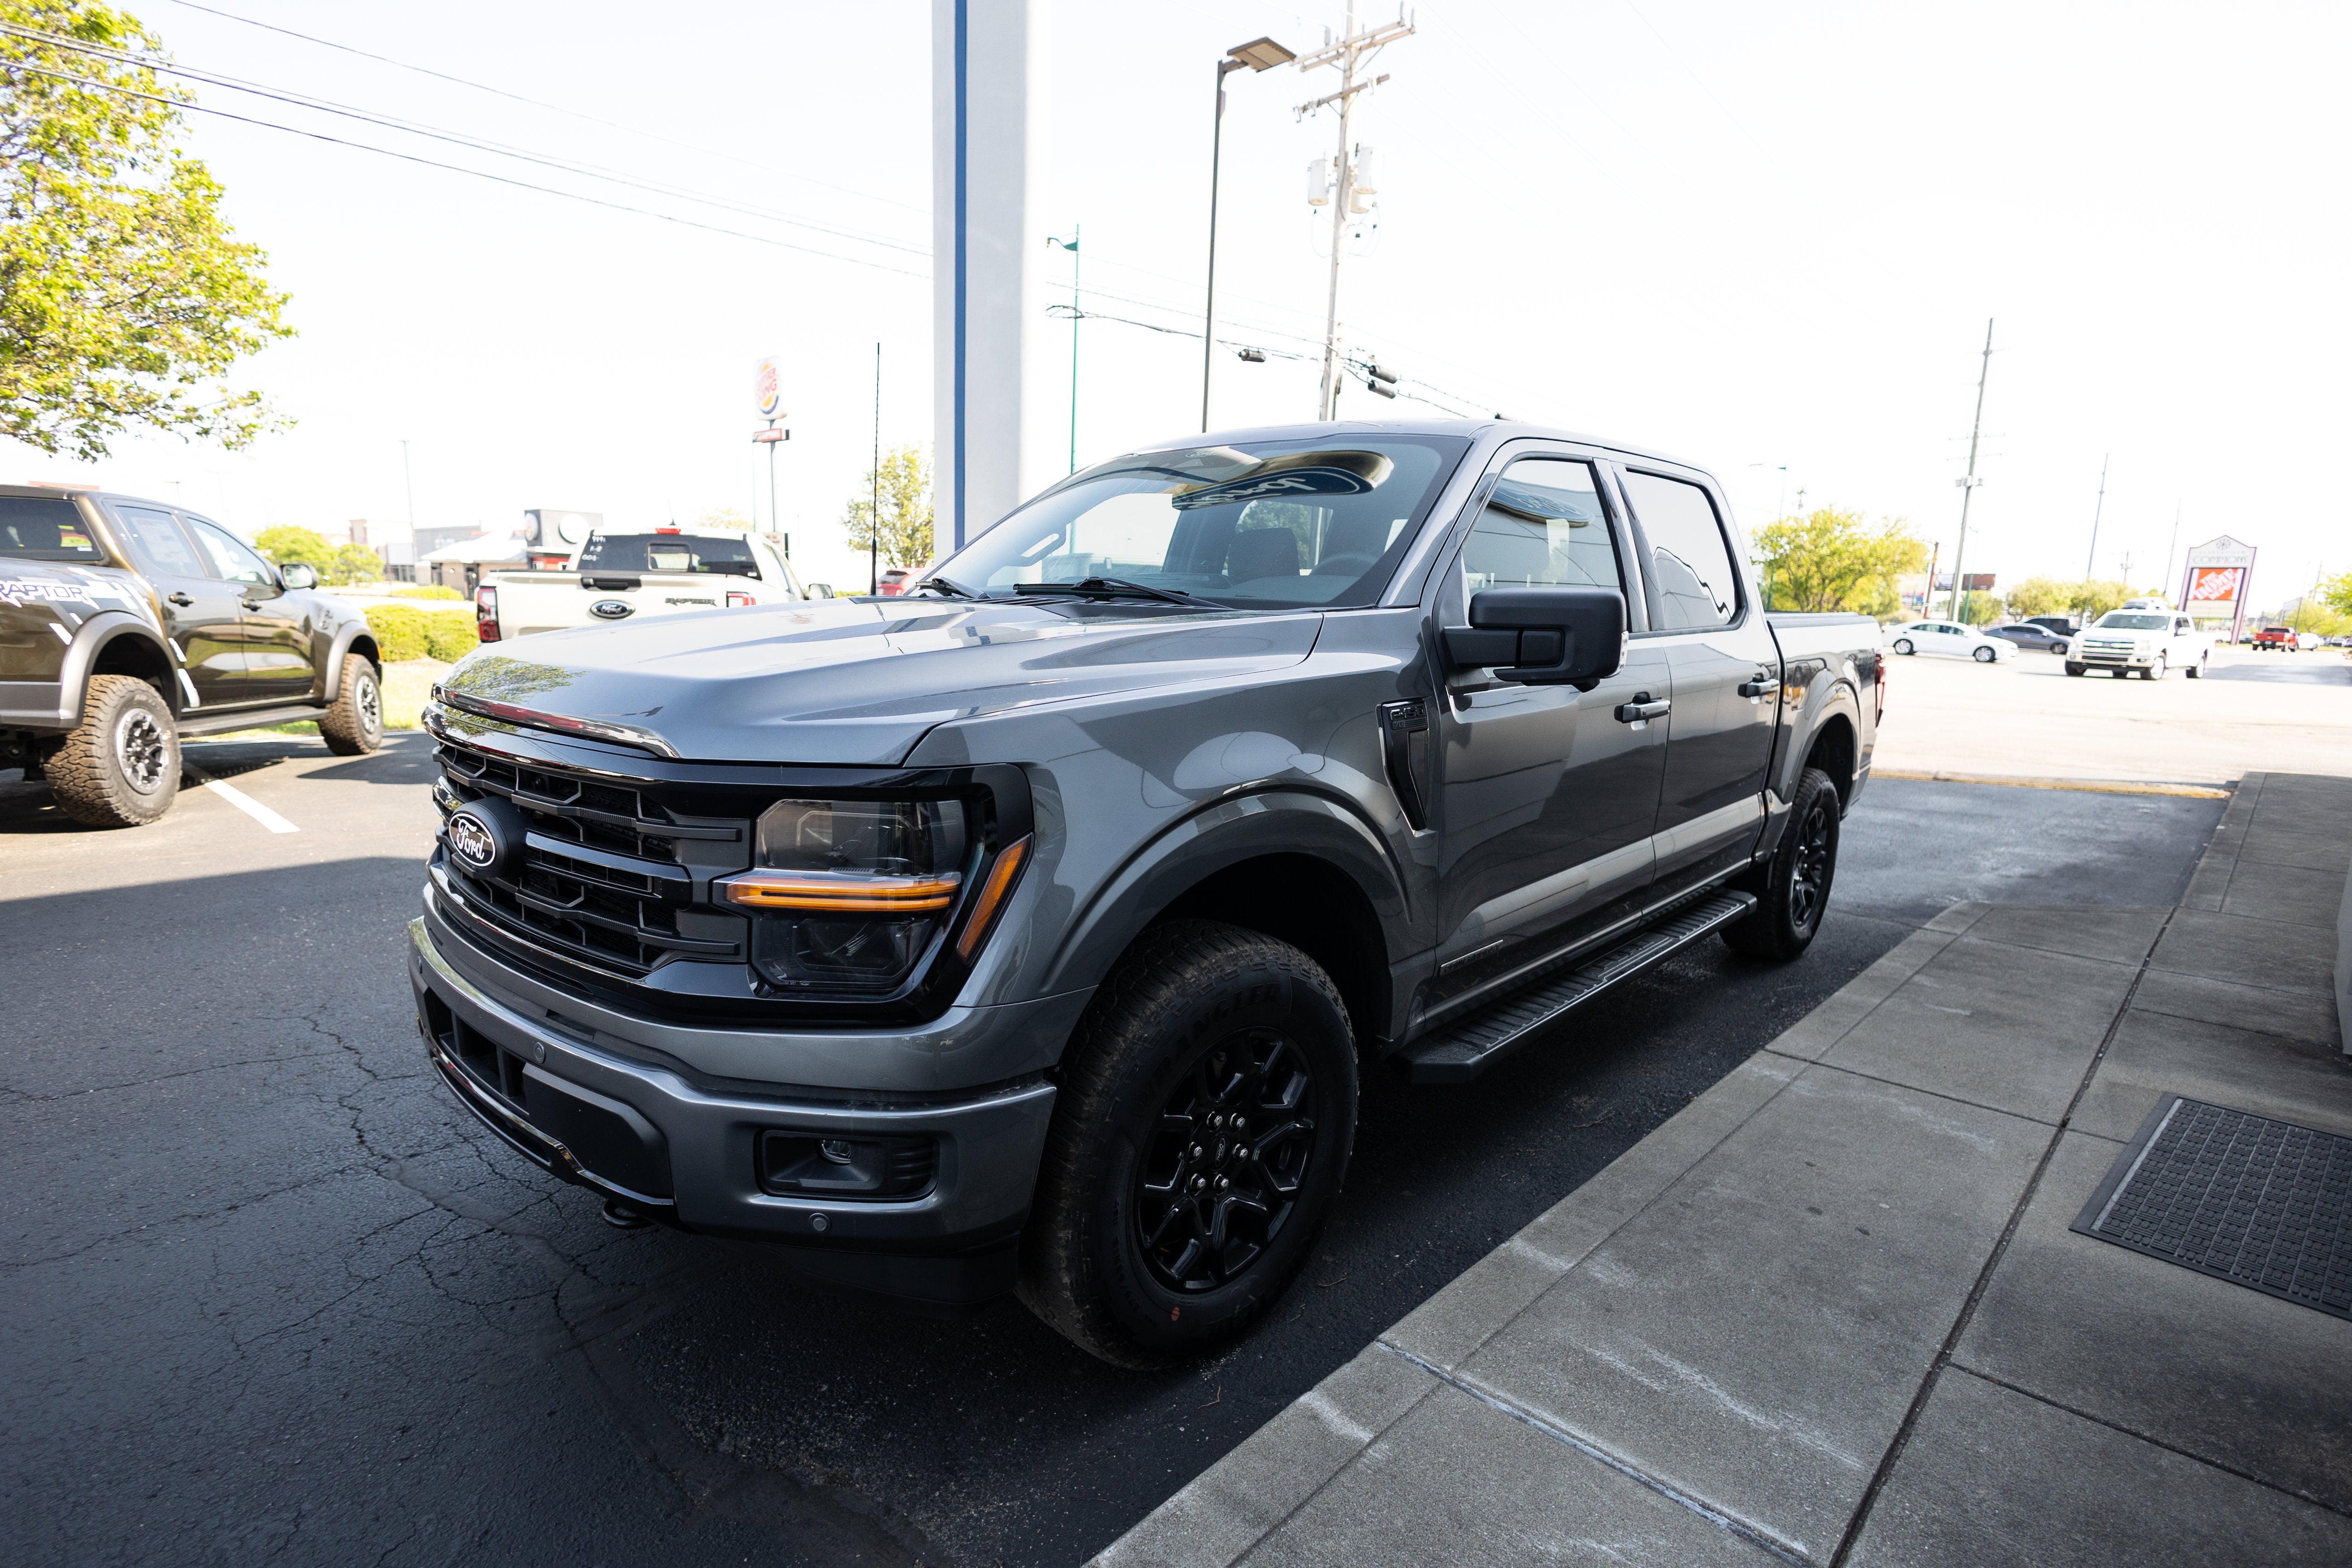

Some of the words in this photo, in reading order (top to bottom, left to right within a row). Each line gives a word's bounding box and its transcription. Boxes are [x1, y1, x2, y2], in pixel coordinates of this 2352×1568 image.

[2193, 555, 2249, 564] COMMONS
[2194, 568, 2235, 599] HOME
[2199, 571, 2217, 584] THE
[2208, 580, 2234, 599] DEPOT
[601, 604, 622, 614] Ford
[1390, 706, 1424, 721] F-150
[456, 819, 484, 860] Ford
[1132, 982, 1281, 1118] WRANGLER
